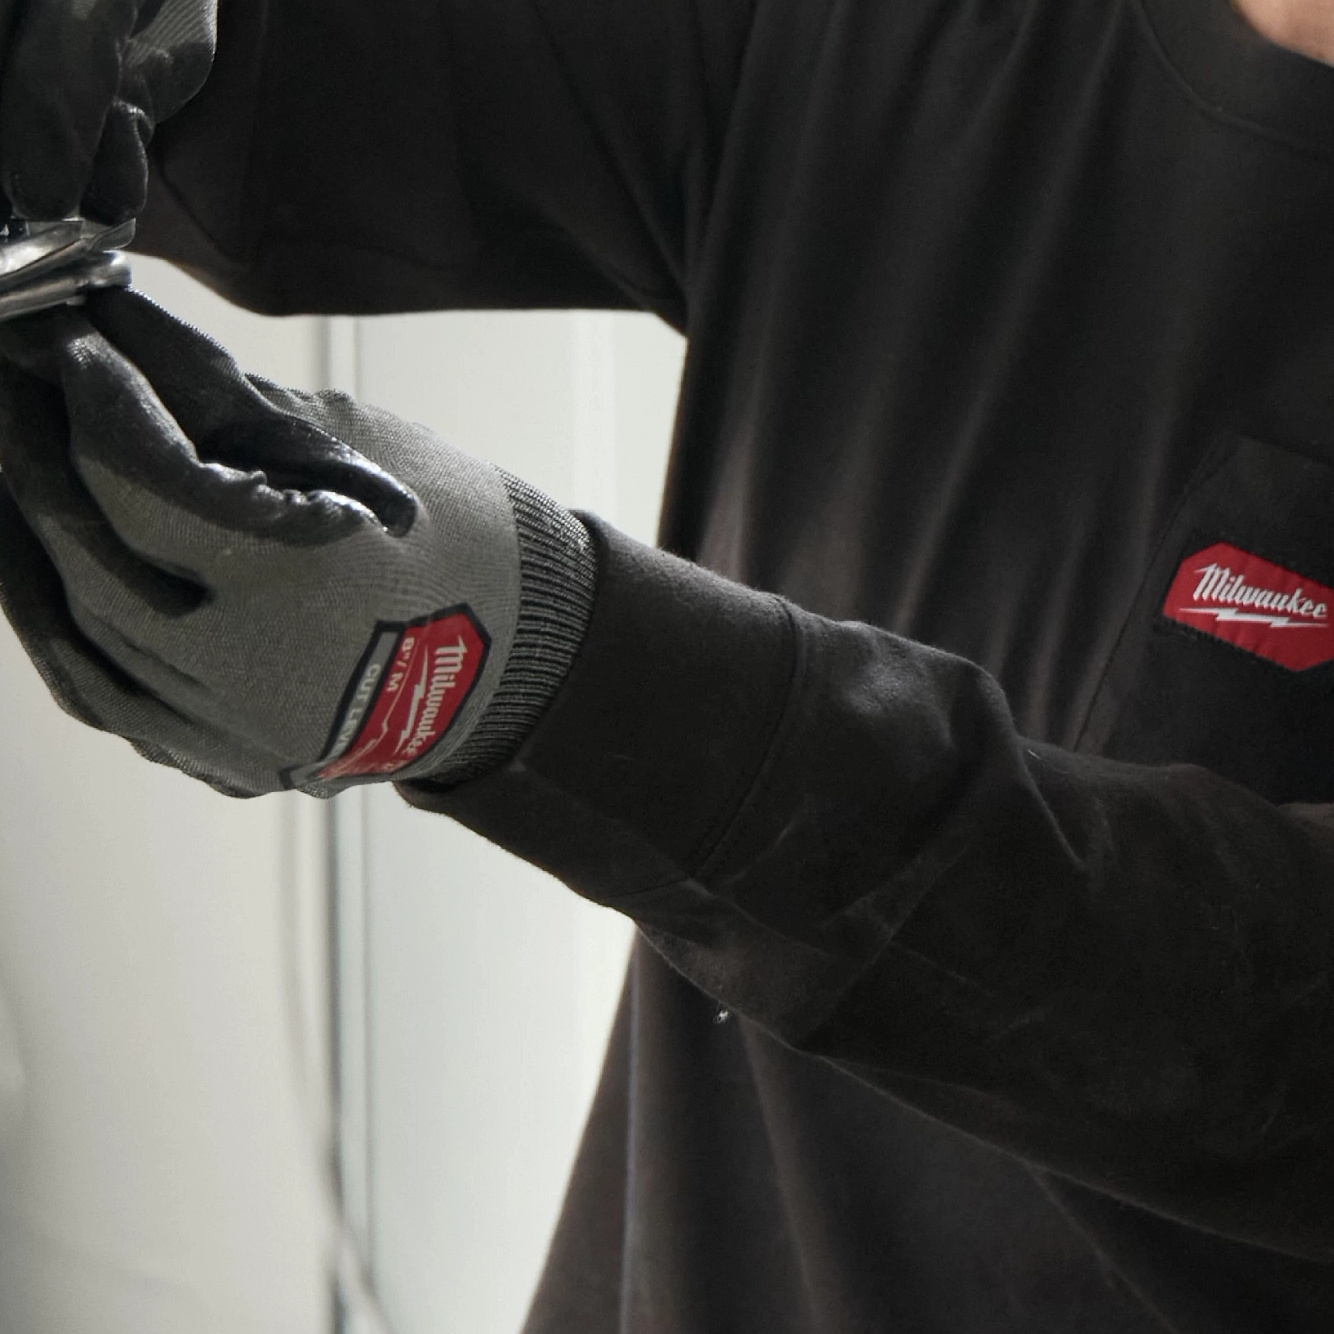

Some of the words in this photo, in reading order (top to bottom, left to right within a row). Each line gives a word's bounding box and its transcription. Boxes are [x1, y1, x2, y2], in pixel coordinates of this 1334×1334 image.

[1194, 562, 1328, 618] Milwaukee
[359, 664, 381, 701] CUT
[403, 635, 468, 756] Milwaukee
